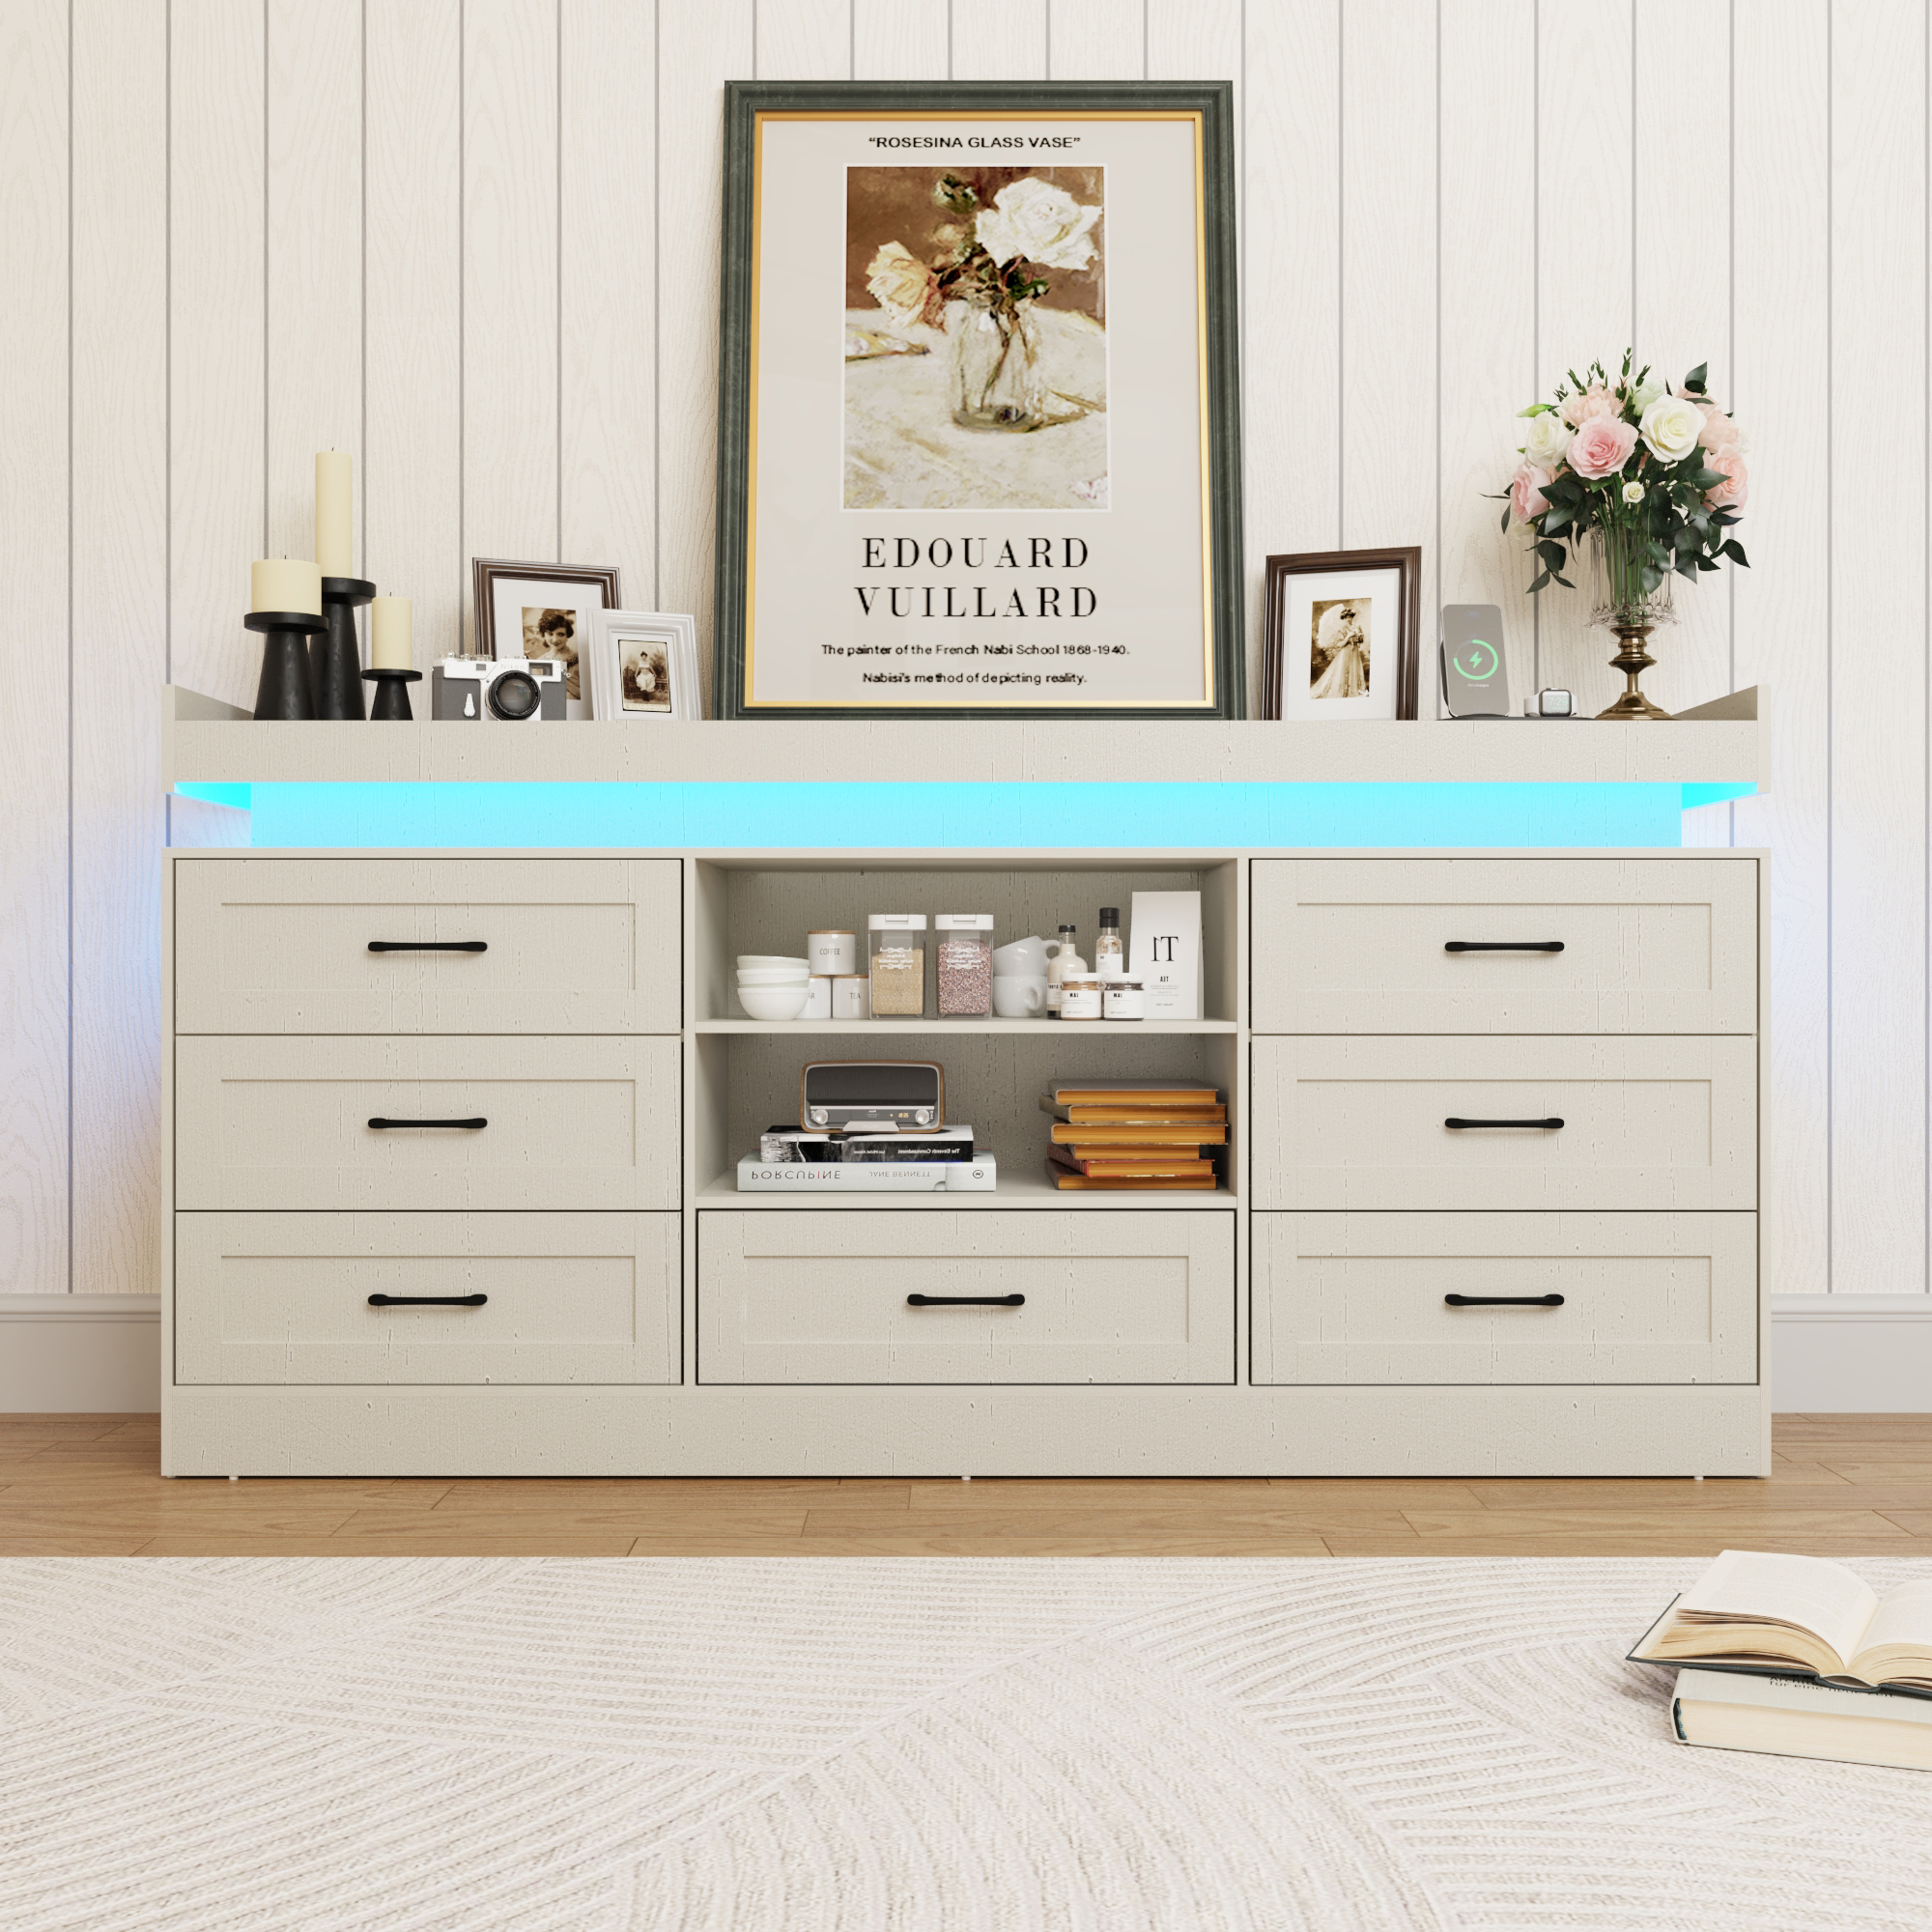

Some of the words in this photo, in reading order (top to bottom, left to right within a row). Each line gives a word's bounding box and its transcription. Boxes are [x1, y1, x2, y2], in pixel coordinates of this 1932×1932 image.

[967, 136, 1025, 149] GLASS
[1027, 136, 1081, 149] VASE”
[861, 537, 1089, 568] EDOUARD
[853, 586, 1097, 617] VUILLARD
[821, 643, 844, 656] The
[846, 643, 893, 658] painter
[895, 643, 909, 656] of
[910, 643, 933, 656] the
[935, 643, 980, 656] French
[982, 643, 1014, 656] Nabi
[1015, 643, 1061, 656] School
[1062, 644, 1130, 656] 1868-1940.
[914, 671, 964, 684] method
[966, 671, 980, 684] of
[981, 671, 1042, 687] depicting
[1045, 671, 1088, 686] reality.
[1548, 696, 1568, 706] 7:29
